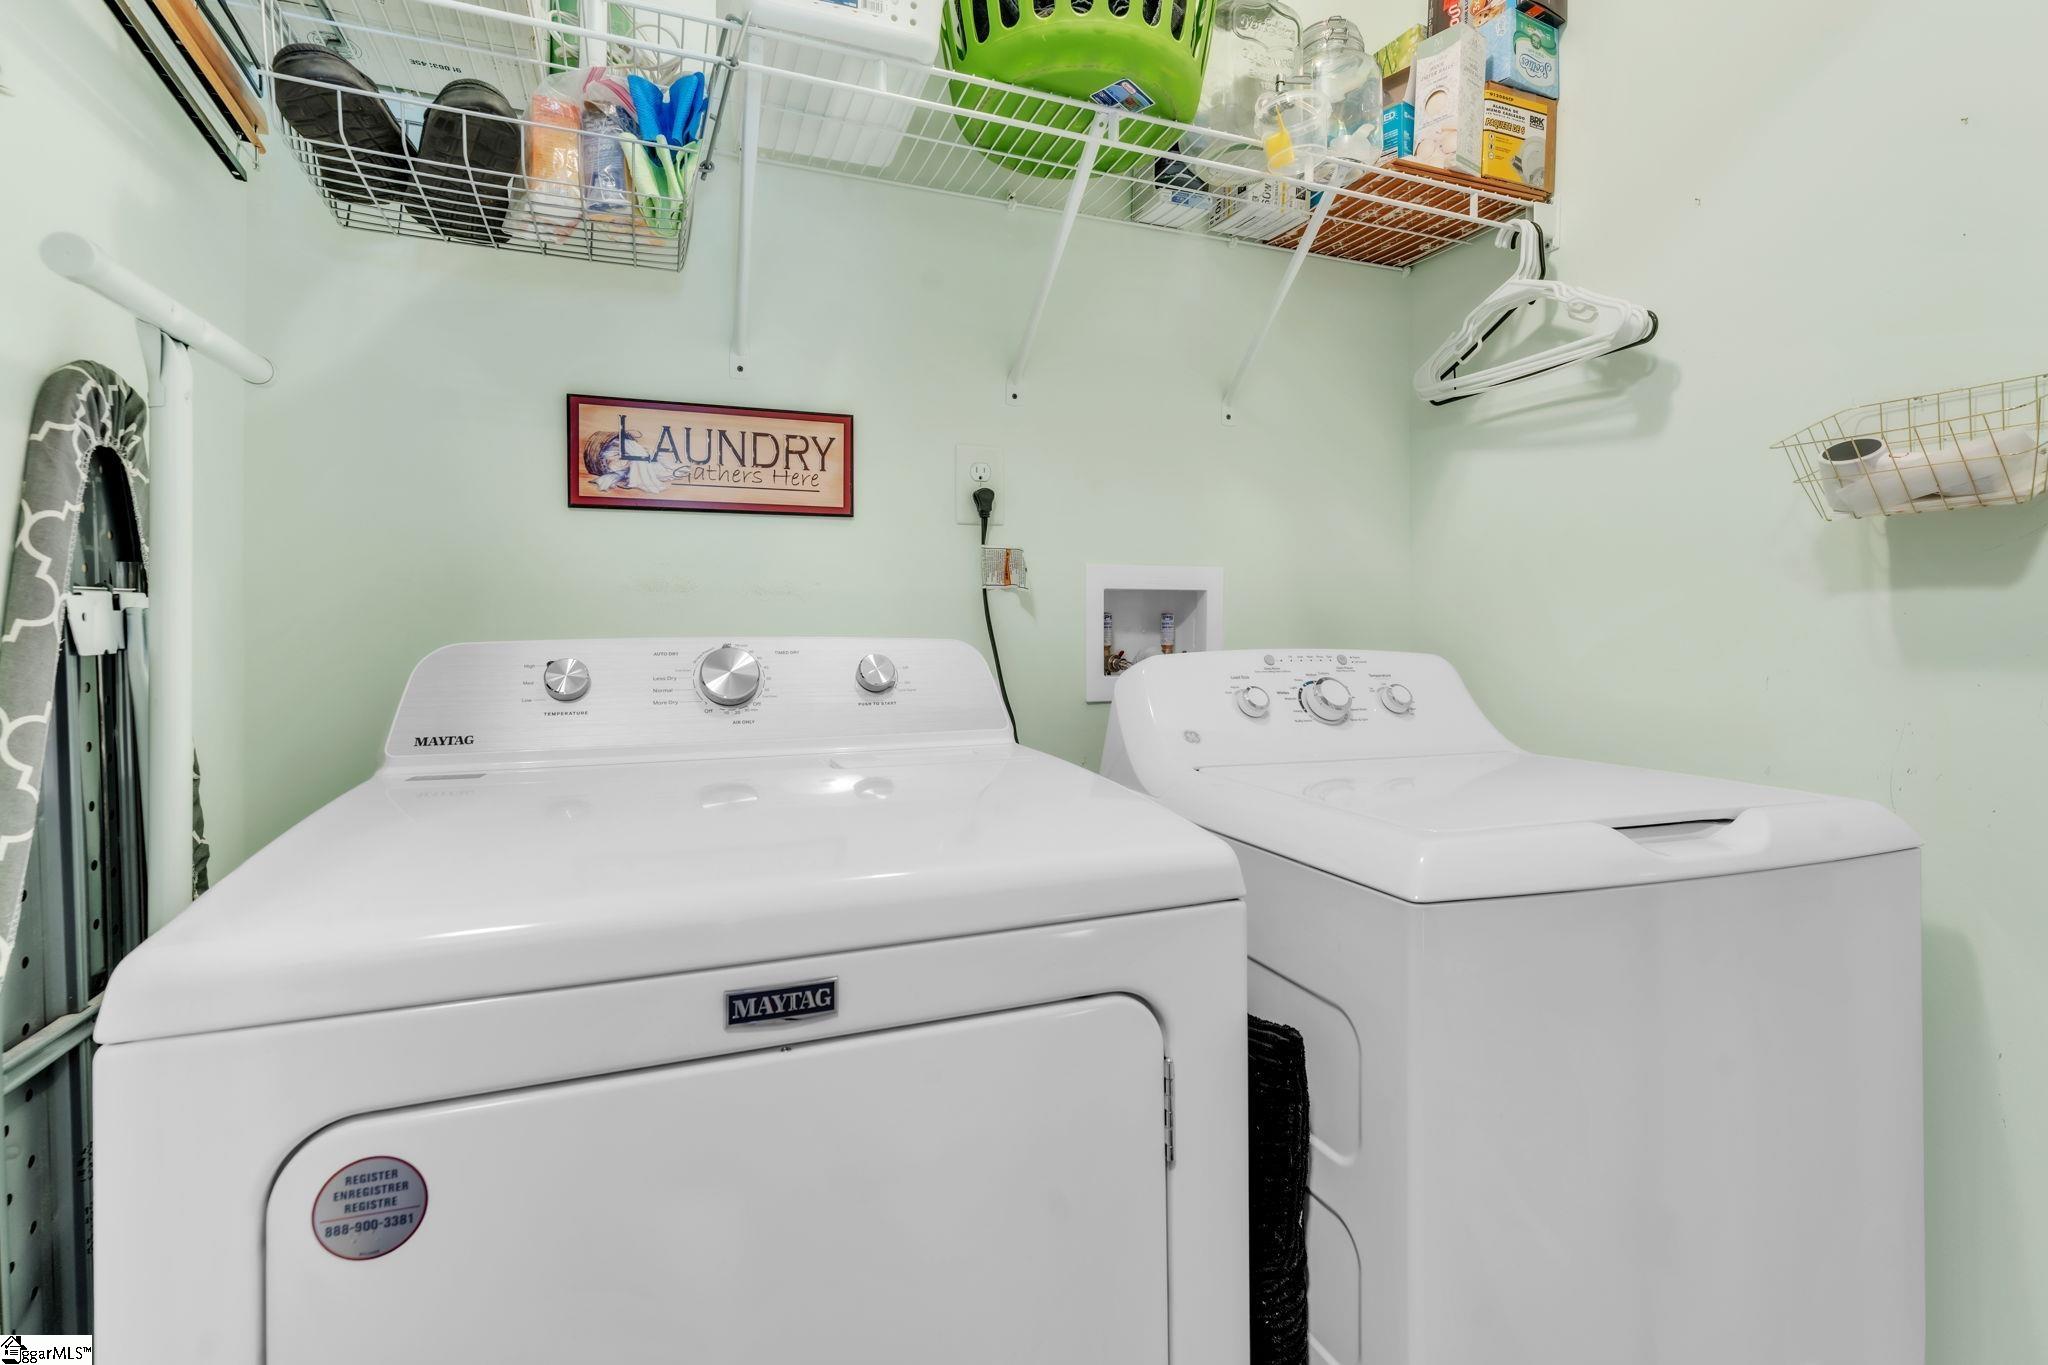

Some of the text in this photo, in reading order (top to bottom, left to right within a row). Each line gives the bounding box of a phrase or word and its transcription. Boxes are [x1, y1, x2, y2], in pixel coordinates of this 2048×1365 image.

[1485, 117, 1511, 131] PAQUETE
[1529, 115, 1545, 127] BRK
[618, 414, 836, 472] LAUNDRY
[672, 464, 820, 487] Gathers Here
[413, 734, 475, 747] MAYTAG
[731, 987, 832, 1019] MAYTAG
[345, 1168, 399, 1186] REGISTER
[333, 1180, 409, 1202] ENREGISTRER
[344, 1195, 398, 1213] REGISTRE
[324, 1212, 415, 1239] 888-900-3381
